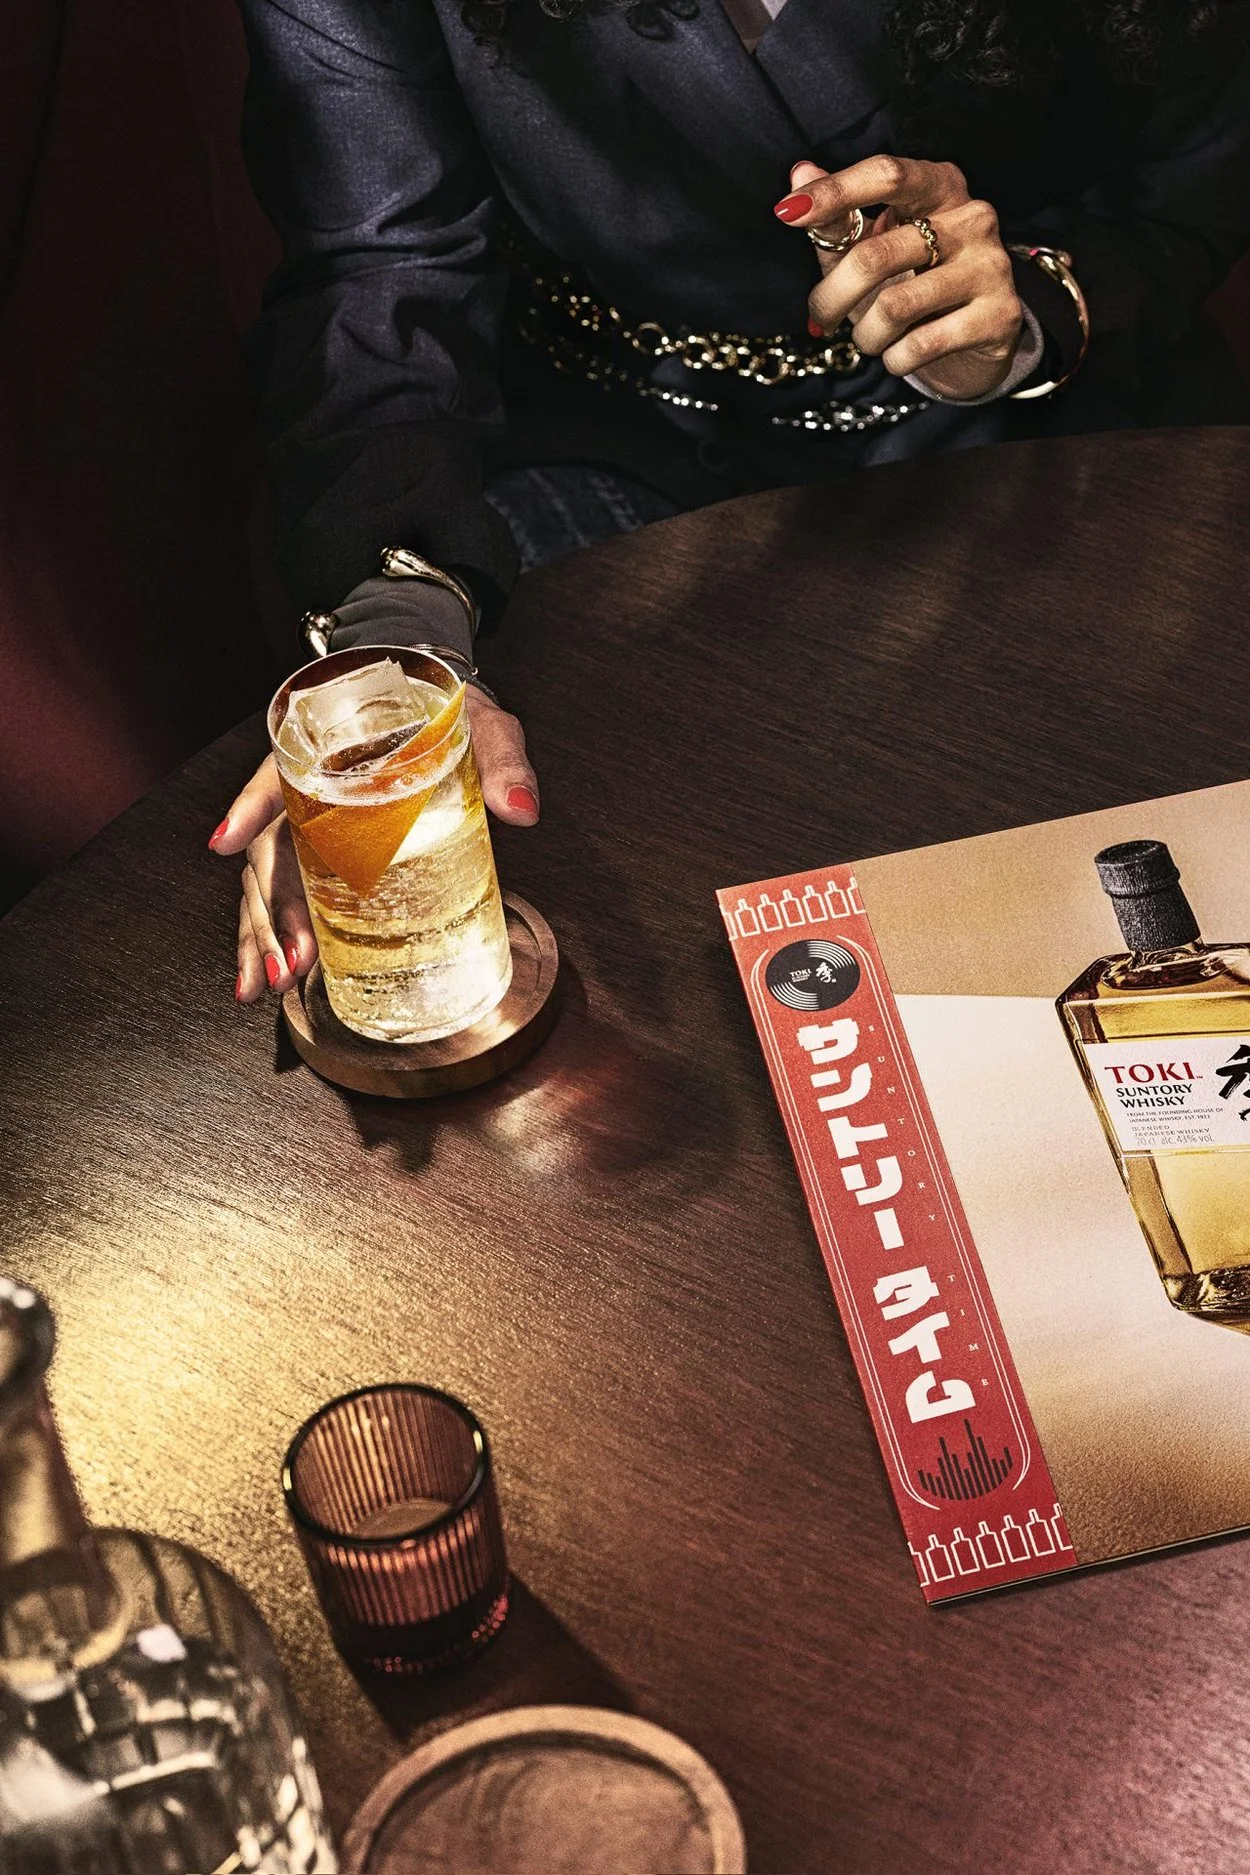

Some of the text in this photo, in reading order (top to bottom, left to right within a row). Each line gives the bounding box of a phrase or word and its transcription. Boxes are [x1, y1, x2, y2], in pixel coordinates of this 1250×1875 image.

[789, 968, 812, 976] TOKI
[815, 962, 833, 983] 季
[1116, 1083, 1193, 1097] SUNTORY
[1120, 1096, 1186, 1109] WHISKY
